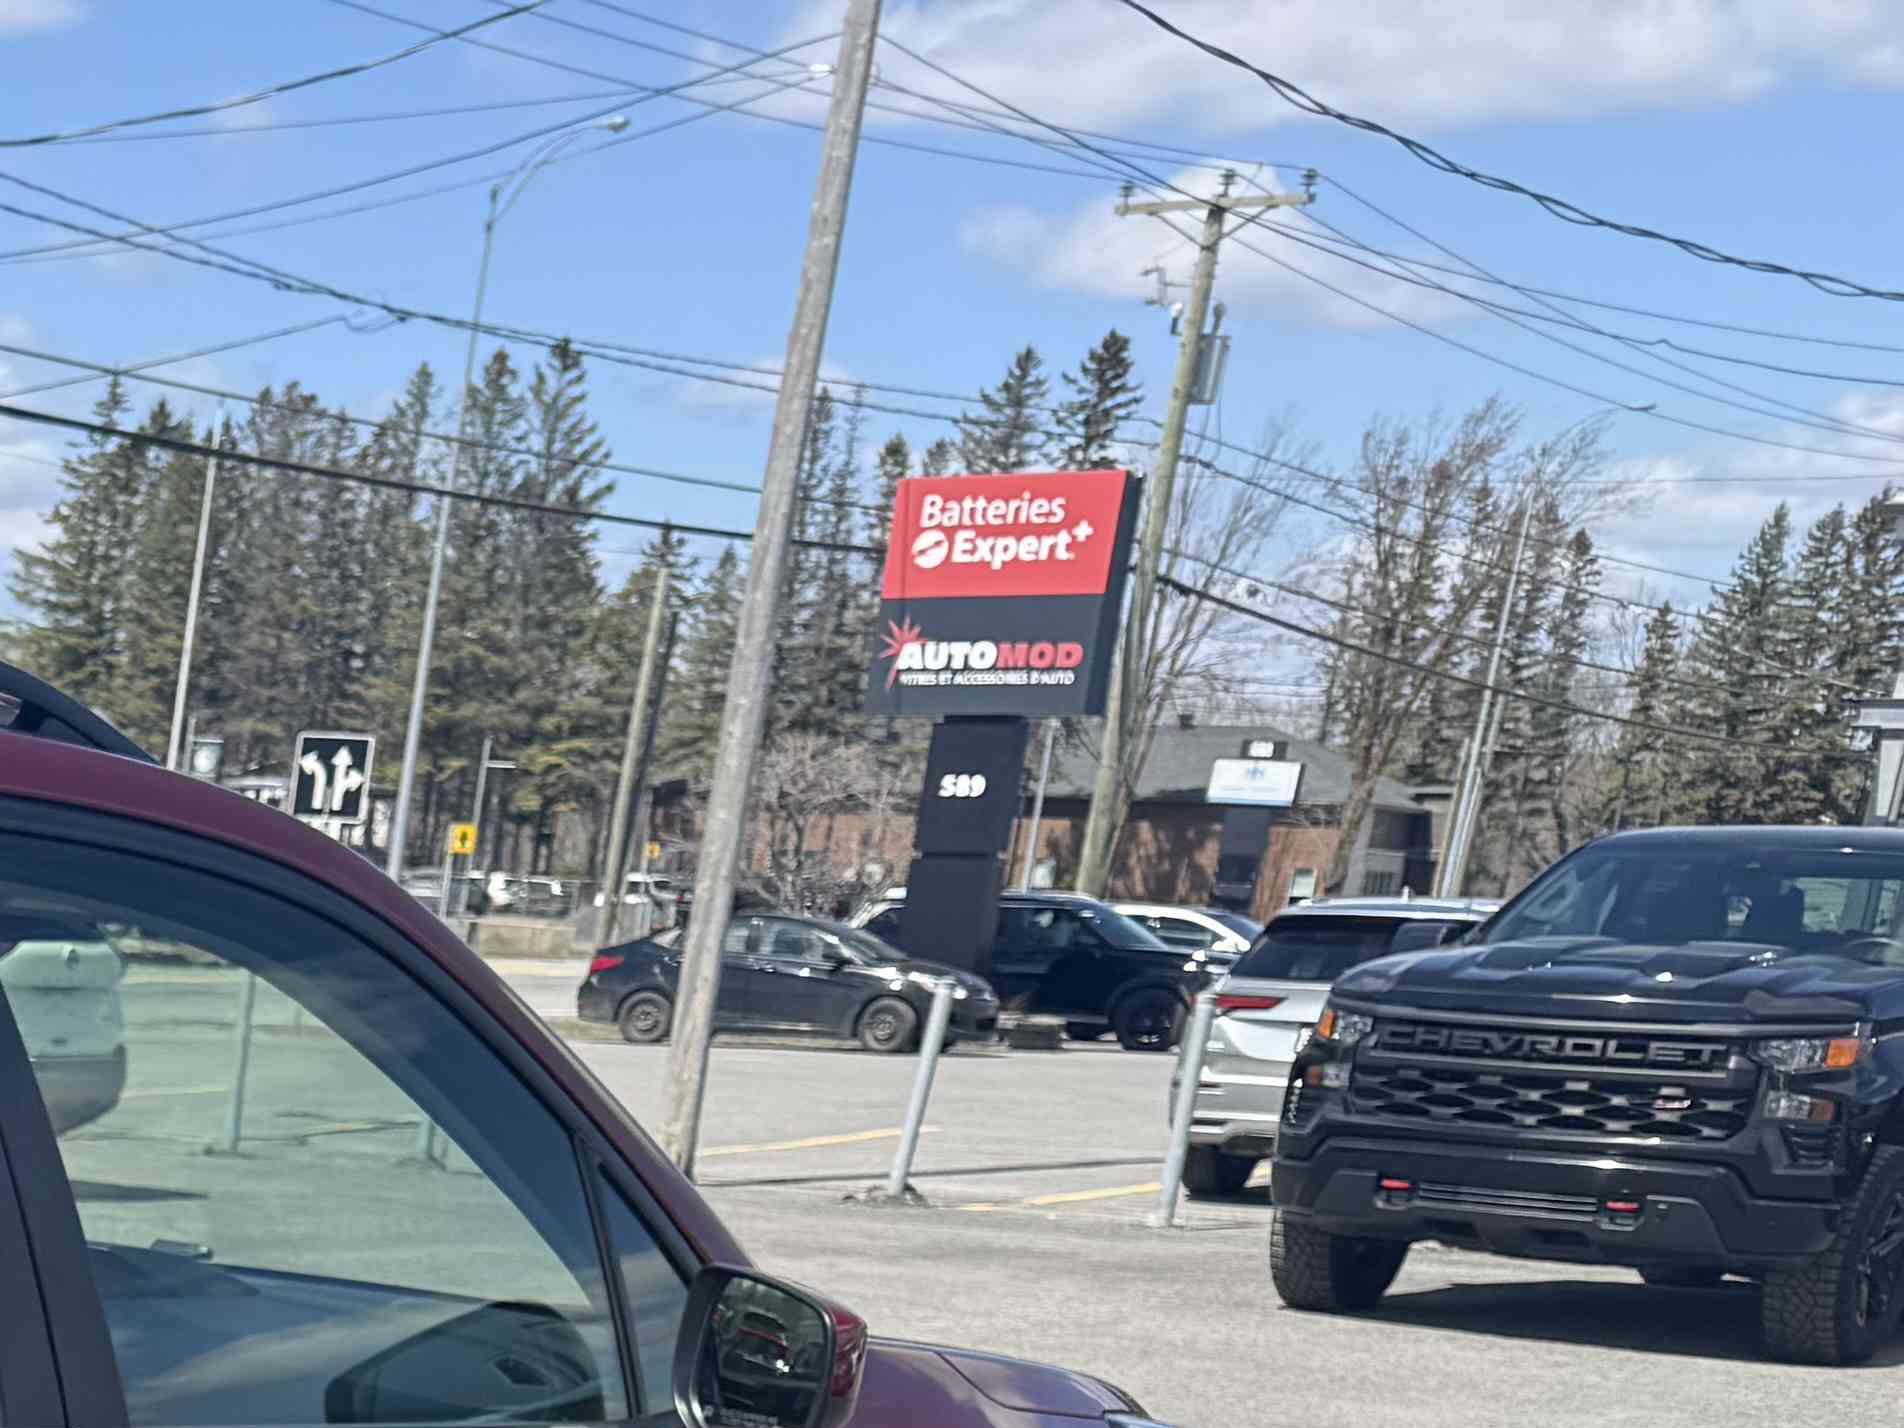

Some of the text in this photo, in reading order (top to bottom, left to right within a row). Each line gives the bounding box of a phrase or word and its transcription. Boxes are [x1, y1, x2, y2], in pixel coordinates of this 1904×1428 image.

[919, 491, 1067, 528] Batteries
[897, 641, 1084, 671] AUTOMOD
[937, 773, 986, 798] 589
[1379, 1024, 1728, 1064] CHEVROLET
